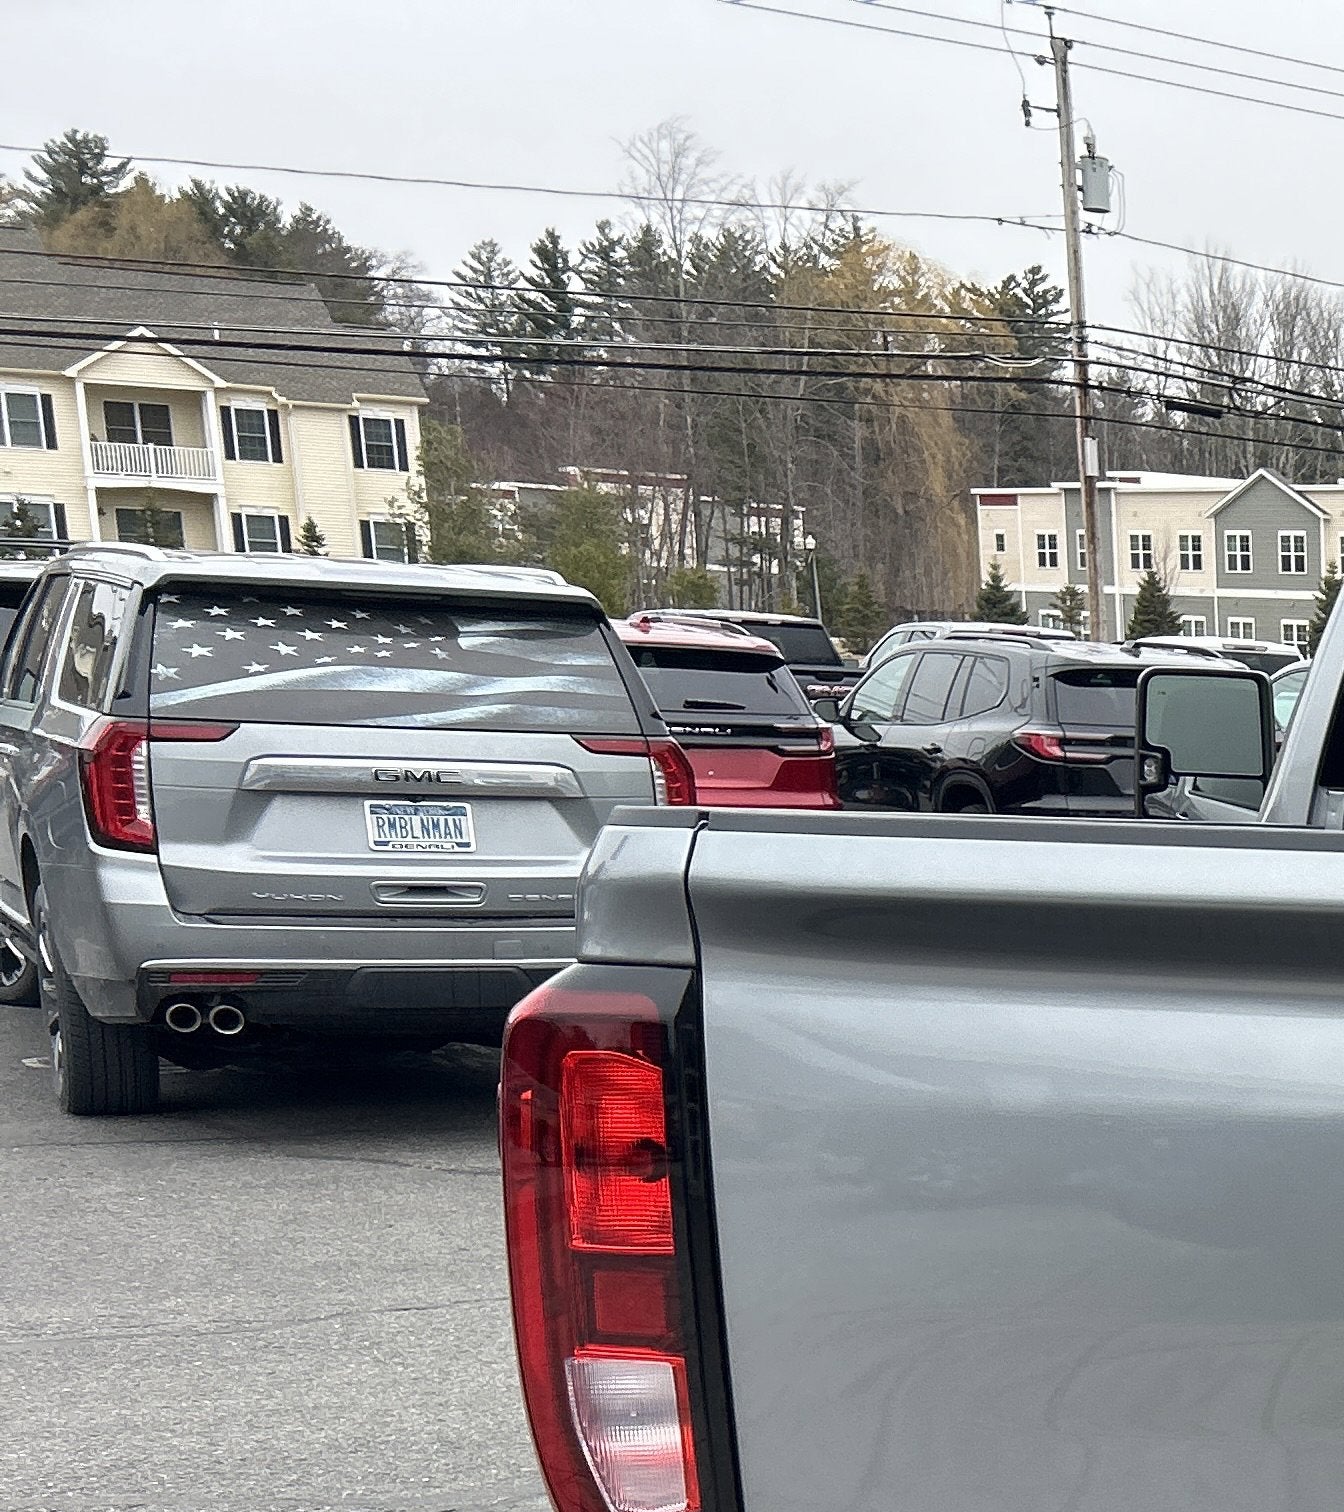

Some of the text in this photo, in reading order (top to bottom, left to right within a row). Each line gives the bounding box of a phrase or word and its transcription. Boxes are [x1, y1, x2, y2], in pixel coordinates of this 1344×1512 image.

[665, 726, 732, 735] ENALI
[374, 768, 462, 784] GMC
[376, 816, 464, 840] RMBLNMAN
[391, 843, 455, 851] DENALI
